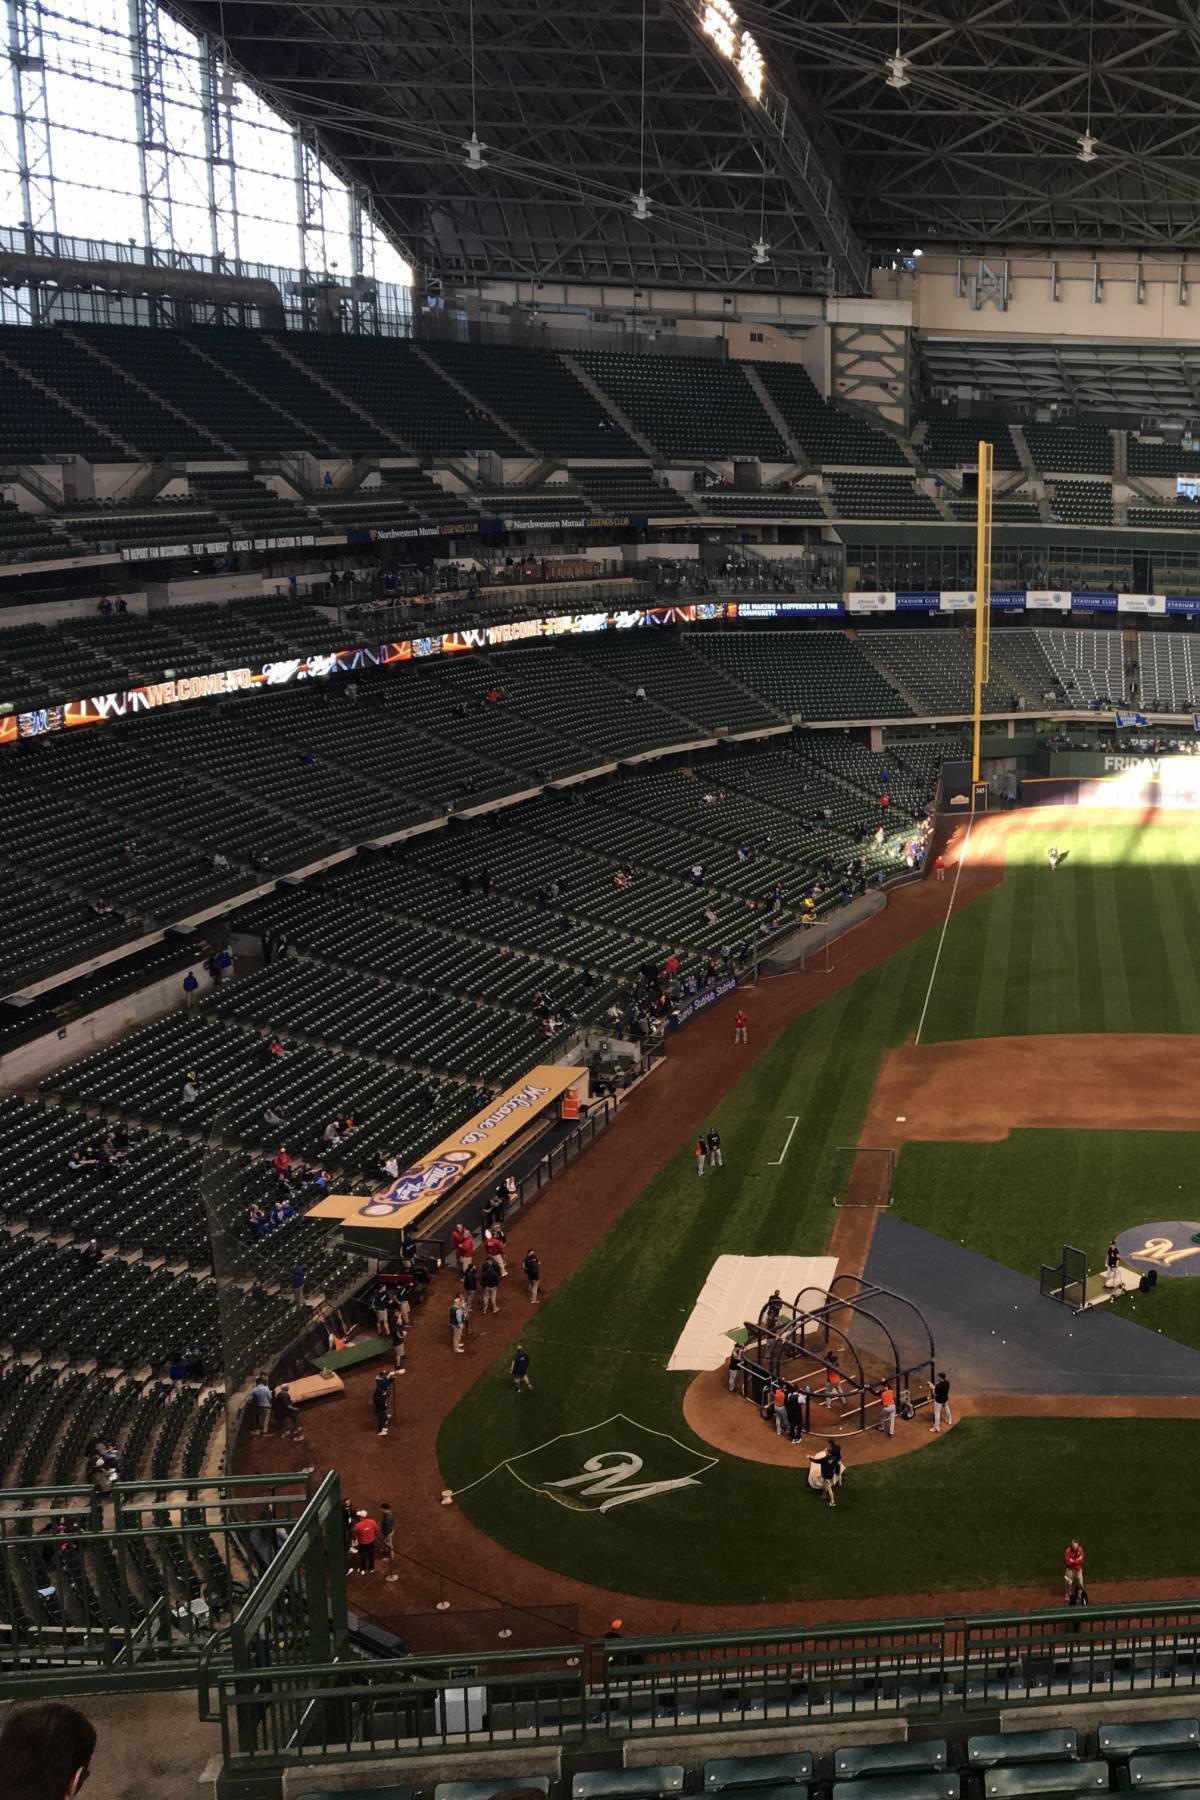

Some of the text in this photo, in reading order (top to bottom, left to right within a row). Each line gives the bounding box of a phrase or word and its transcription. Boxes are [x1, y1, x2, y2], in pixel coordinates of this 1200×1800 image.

[376, 522, 479, 540] Northwestern Mutual LEGENDS CLUB
[513, 516, 630, 530] Northwestern Mutual LEGENDS CLUB
[130, 547, 149, 560] REPORT
[487, 619, 544, 645] WELCOME
[148, 675, 225, 706] WELCOME
[459, 1085, 551, 1145] Welcome to
